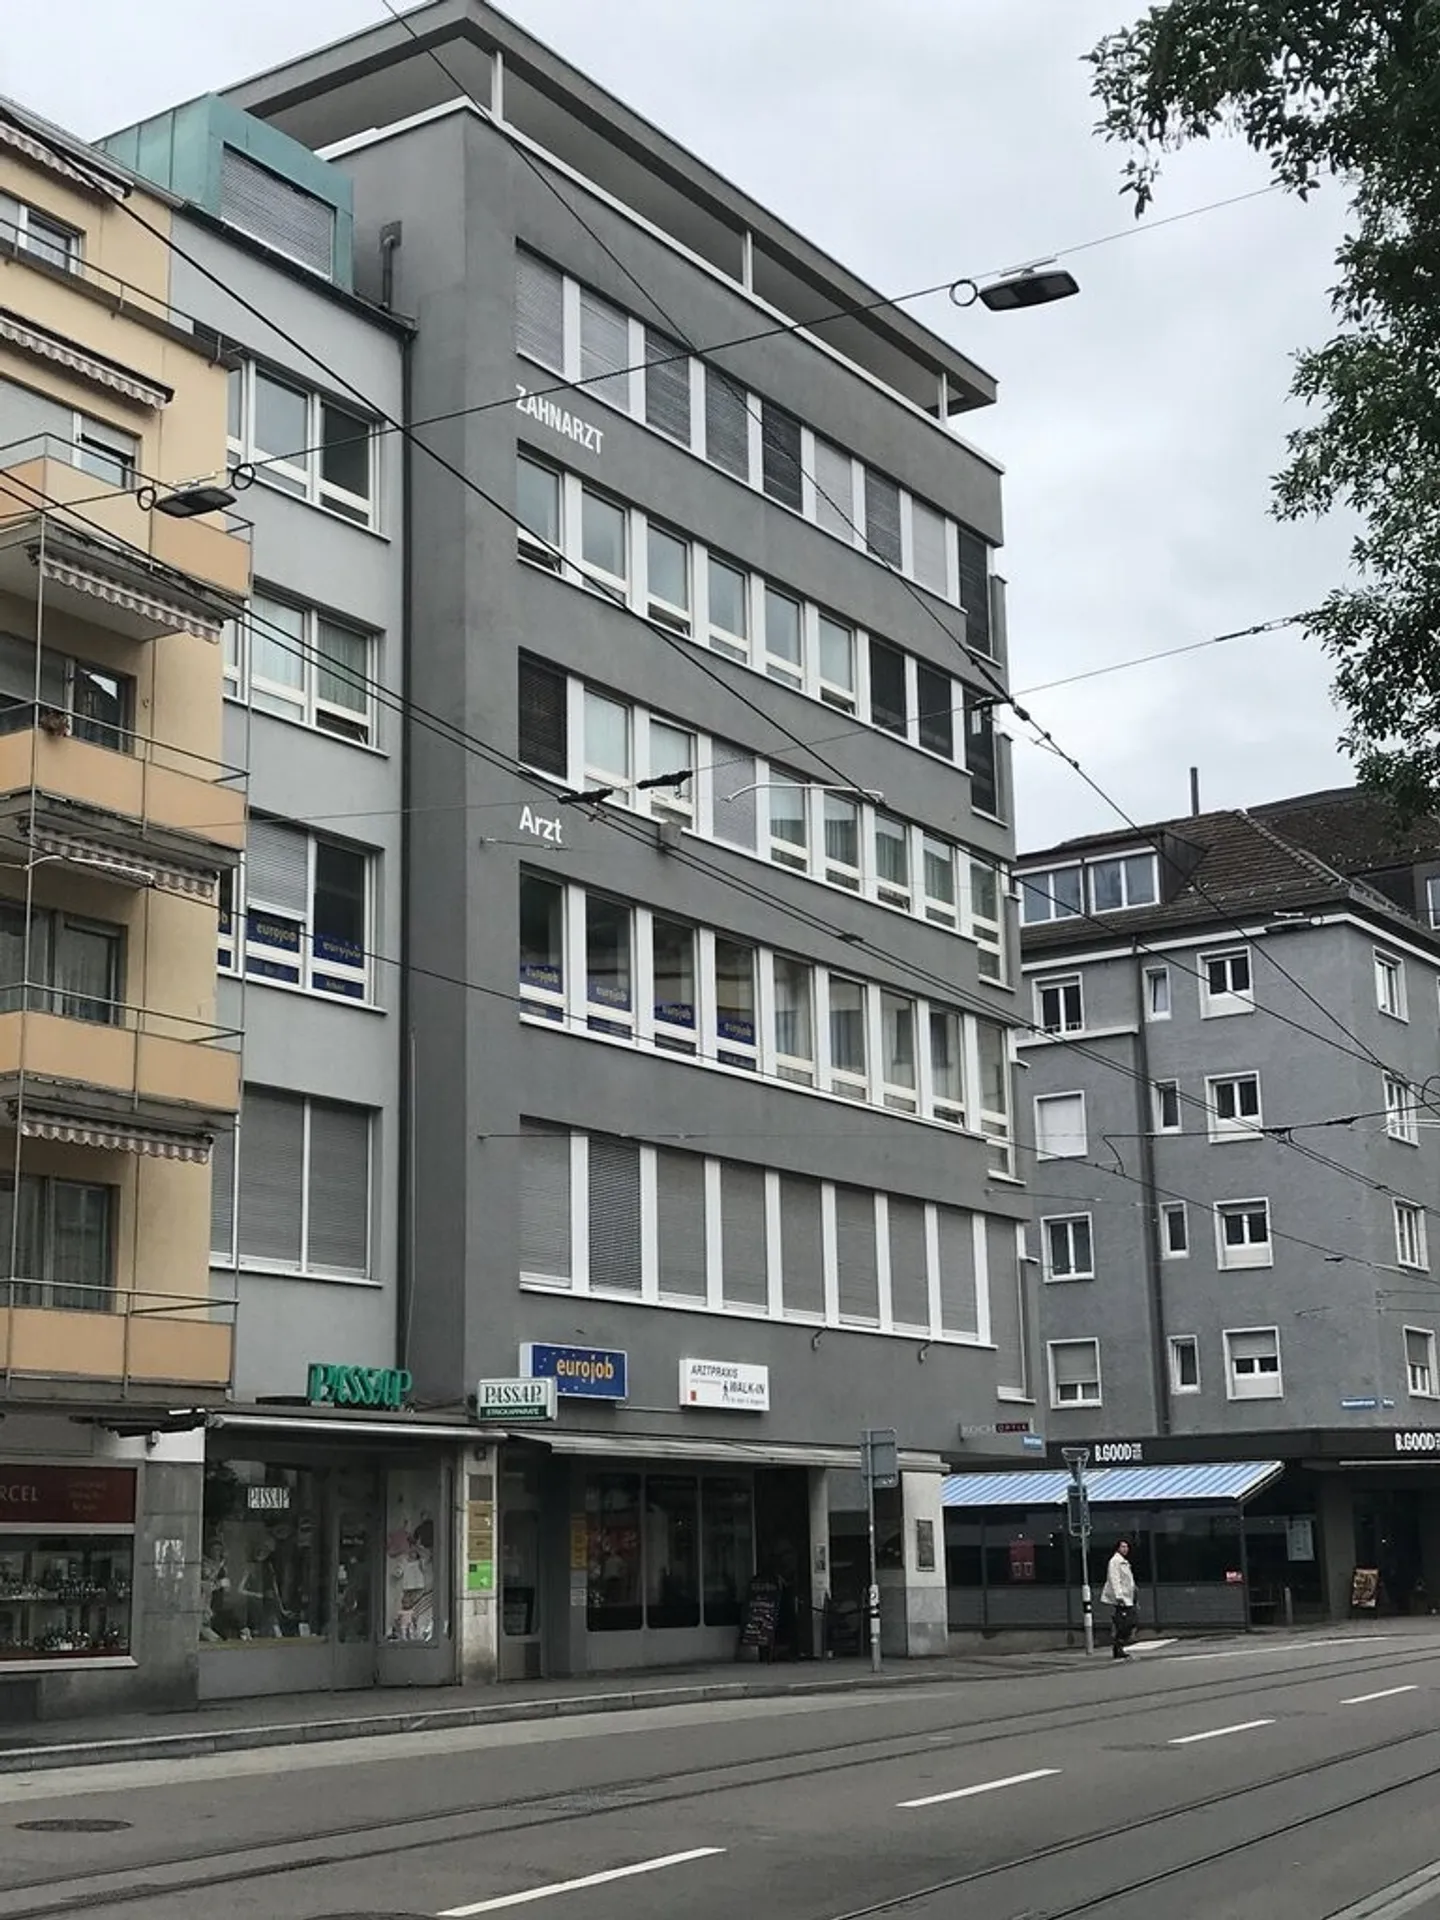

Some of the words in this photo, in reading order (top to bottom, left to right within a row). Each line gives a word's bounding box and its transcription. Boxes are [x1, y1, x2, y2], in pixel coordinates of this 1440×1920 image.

[516, 384, 604, 454] ZAHNARZT
[519, 805, 563, 844] Arzt
[556, 1353, 615, 1385] eurojob
[690, 1364, 739, 1379] ARZTPRAXIS
[306, 1363, 413, 1407] PASSAP
[484, 1385, 542, 1404] PASSAP
[1095, 1443, 1132, 1461] B.GOOD
[1395, 1432, 1436, 1451] B.GOOD
